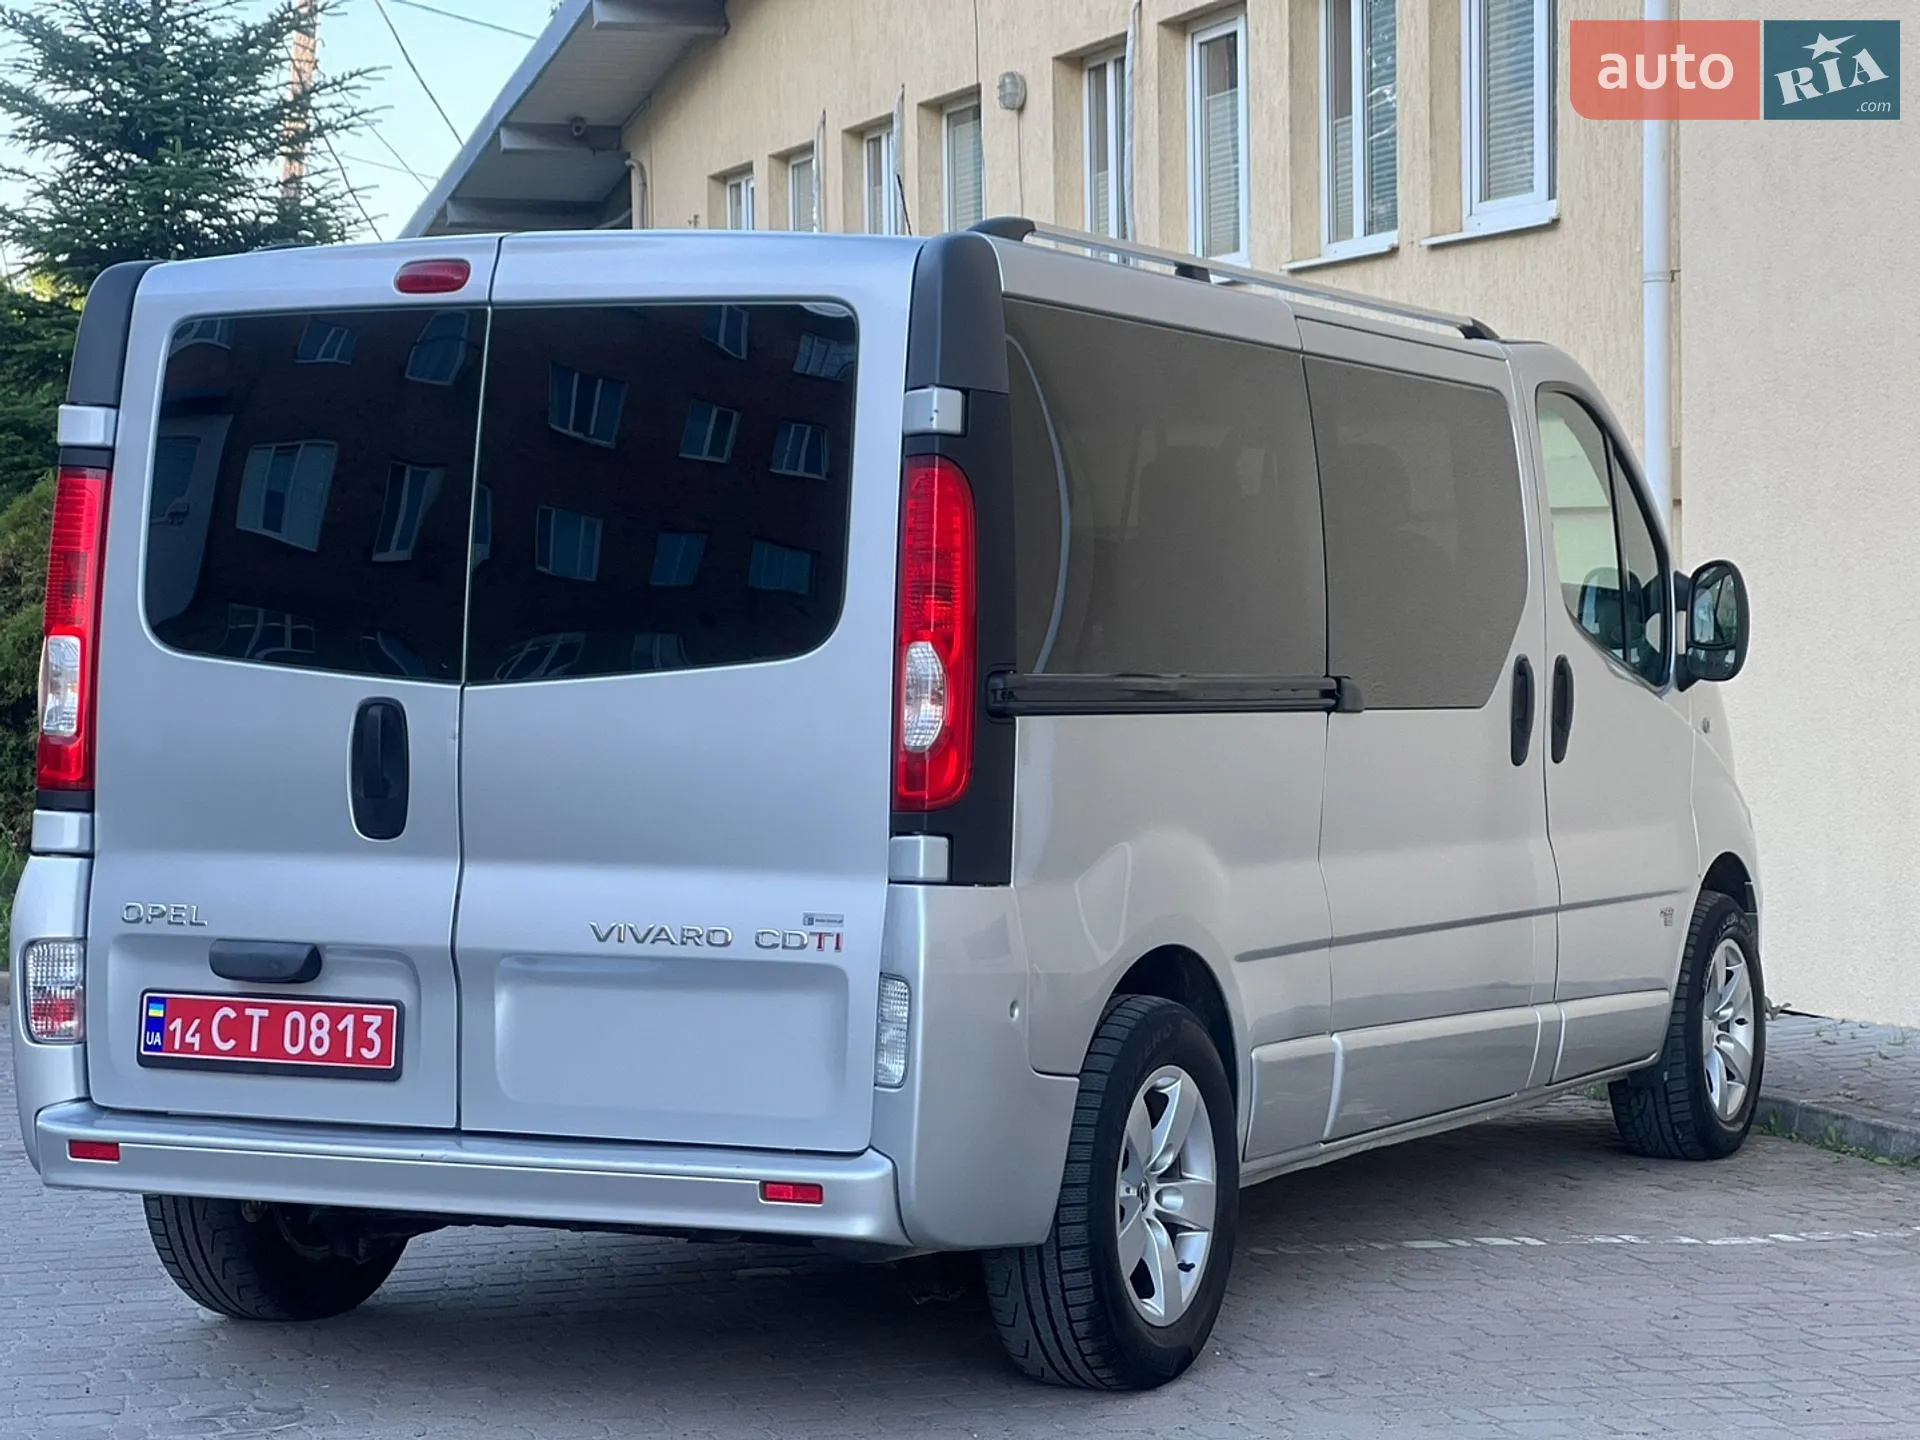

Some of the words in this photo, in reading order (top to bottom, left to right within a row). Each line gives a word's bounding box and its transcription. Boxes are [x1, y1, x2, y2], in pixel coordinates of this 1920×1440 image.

[121, 902, 208, 926] OPEL
[589, 920, 733, 948] VIVARO
[754, 928, 843, 952] CDTI
[146, 1030, 162, 1047] UA
[168, 1017, 201, 1052] 14
[211, 1006, 270, 1052] CT
[282, 1010, 382, 1060] 0813
